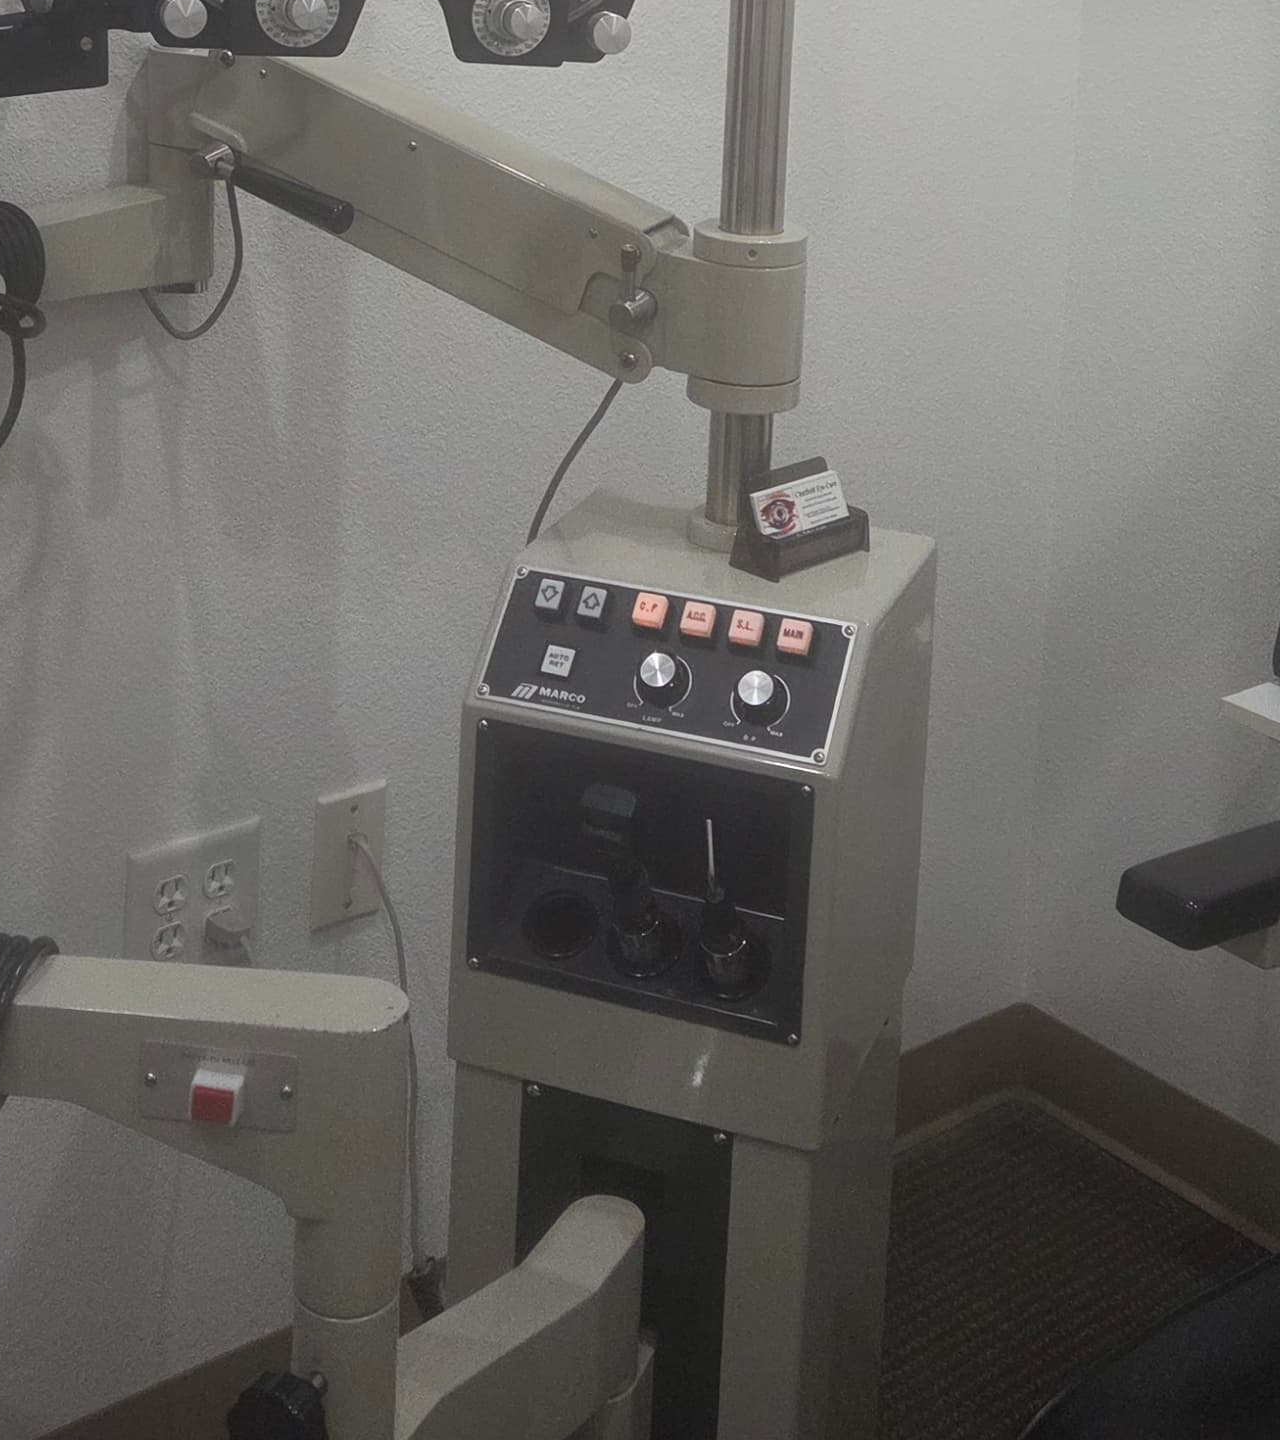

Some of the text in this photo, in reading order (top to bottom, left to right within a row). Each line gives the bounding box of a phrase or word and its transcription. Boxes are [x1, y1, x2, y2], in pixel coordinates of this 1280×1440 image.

[782, 627, 804, 640] MAIN
[548, 651, 570, 663] AUTO
[538, 686, 586, 703] MARCO
